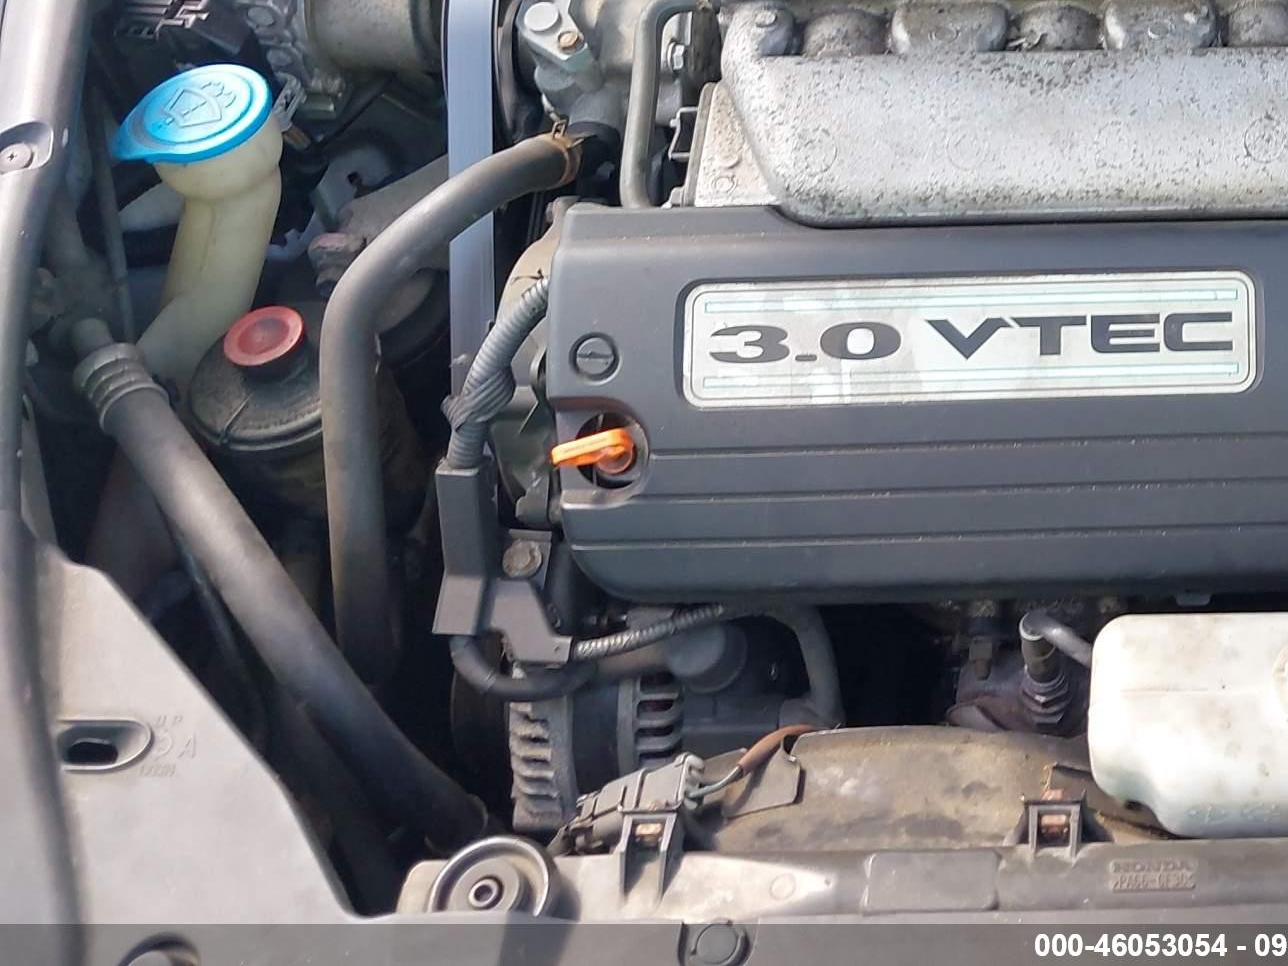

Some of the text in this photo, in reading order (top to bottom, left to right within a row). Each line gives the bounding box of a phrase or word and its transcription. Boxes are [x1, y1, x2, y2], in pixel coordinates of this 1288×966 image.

[709, 311, 1233, 364] 3.0 VTEC
[1112, 860, 1193, 873] HONDA
